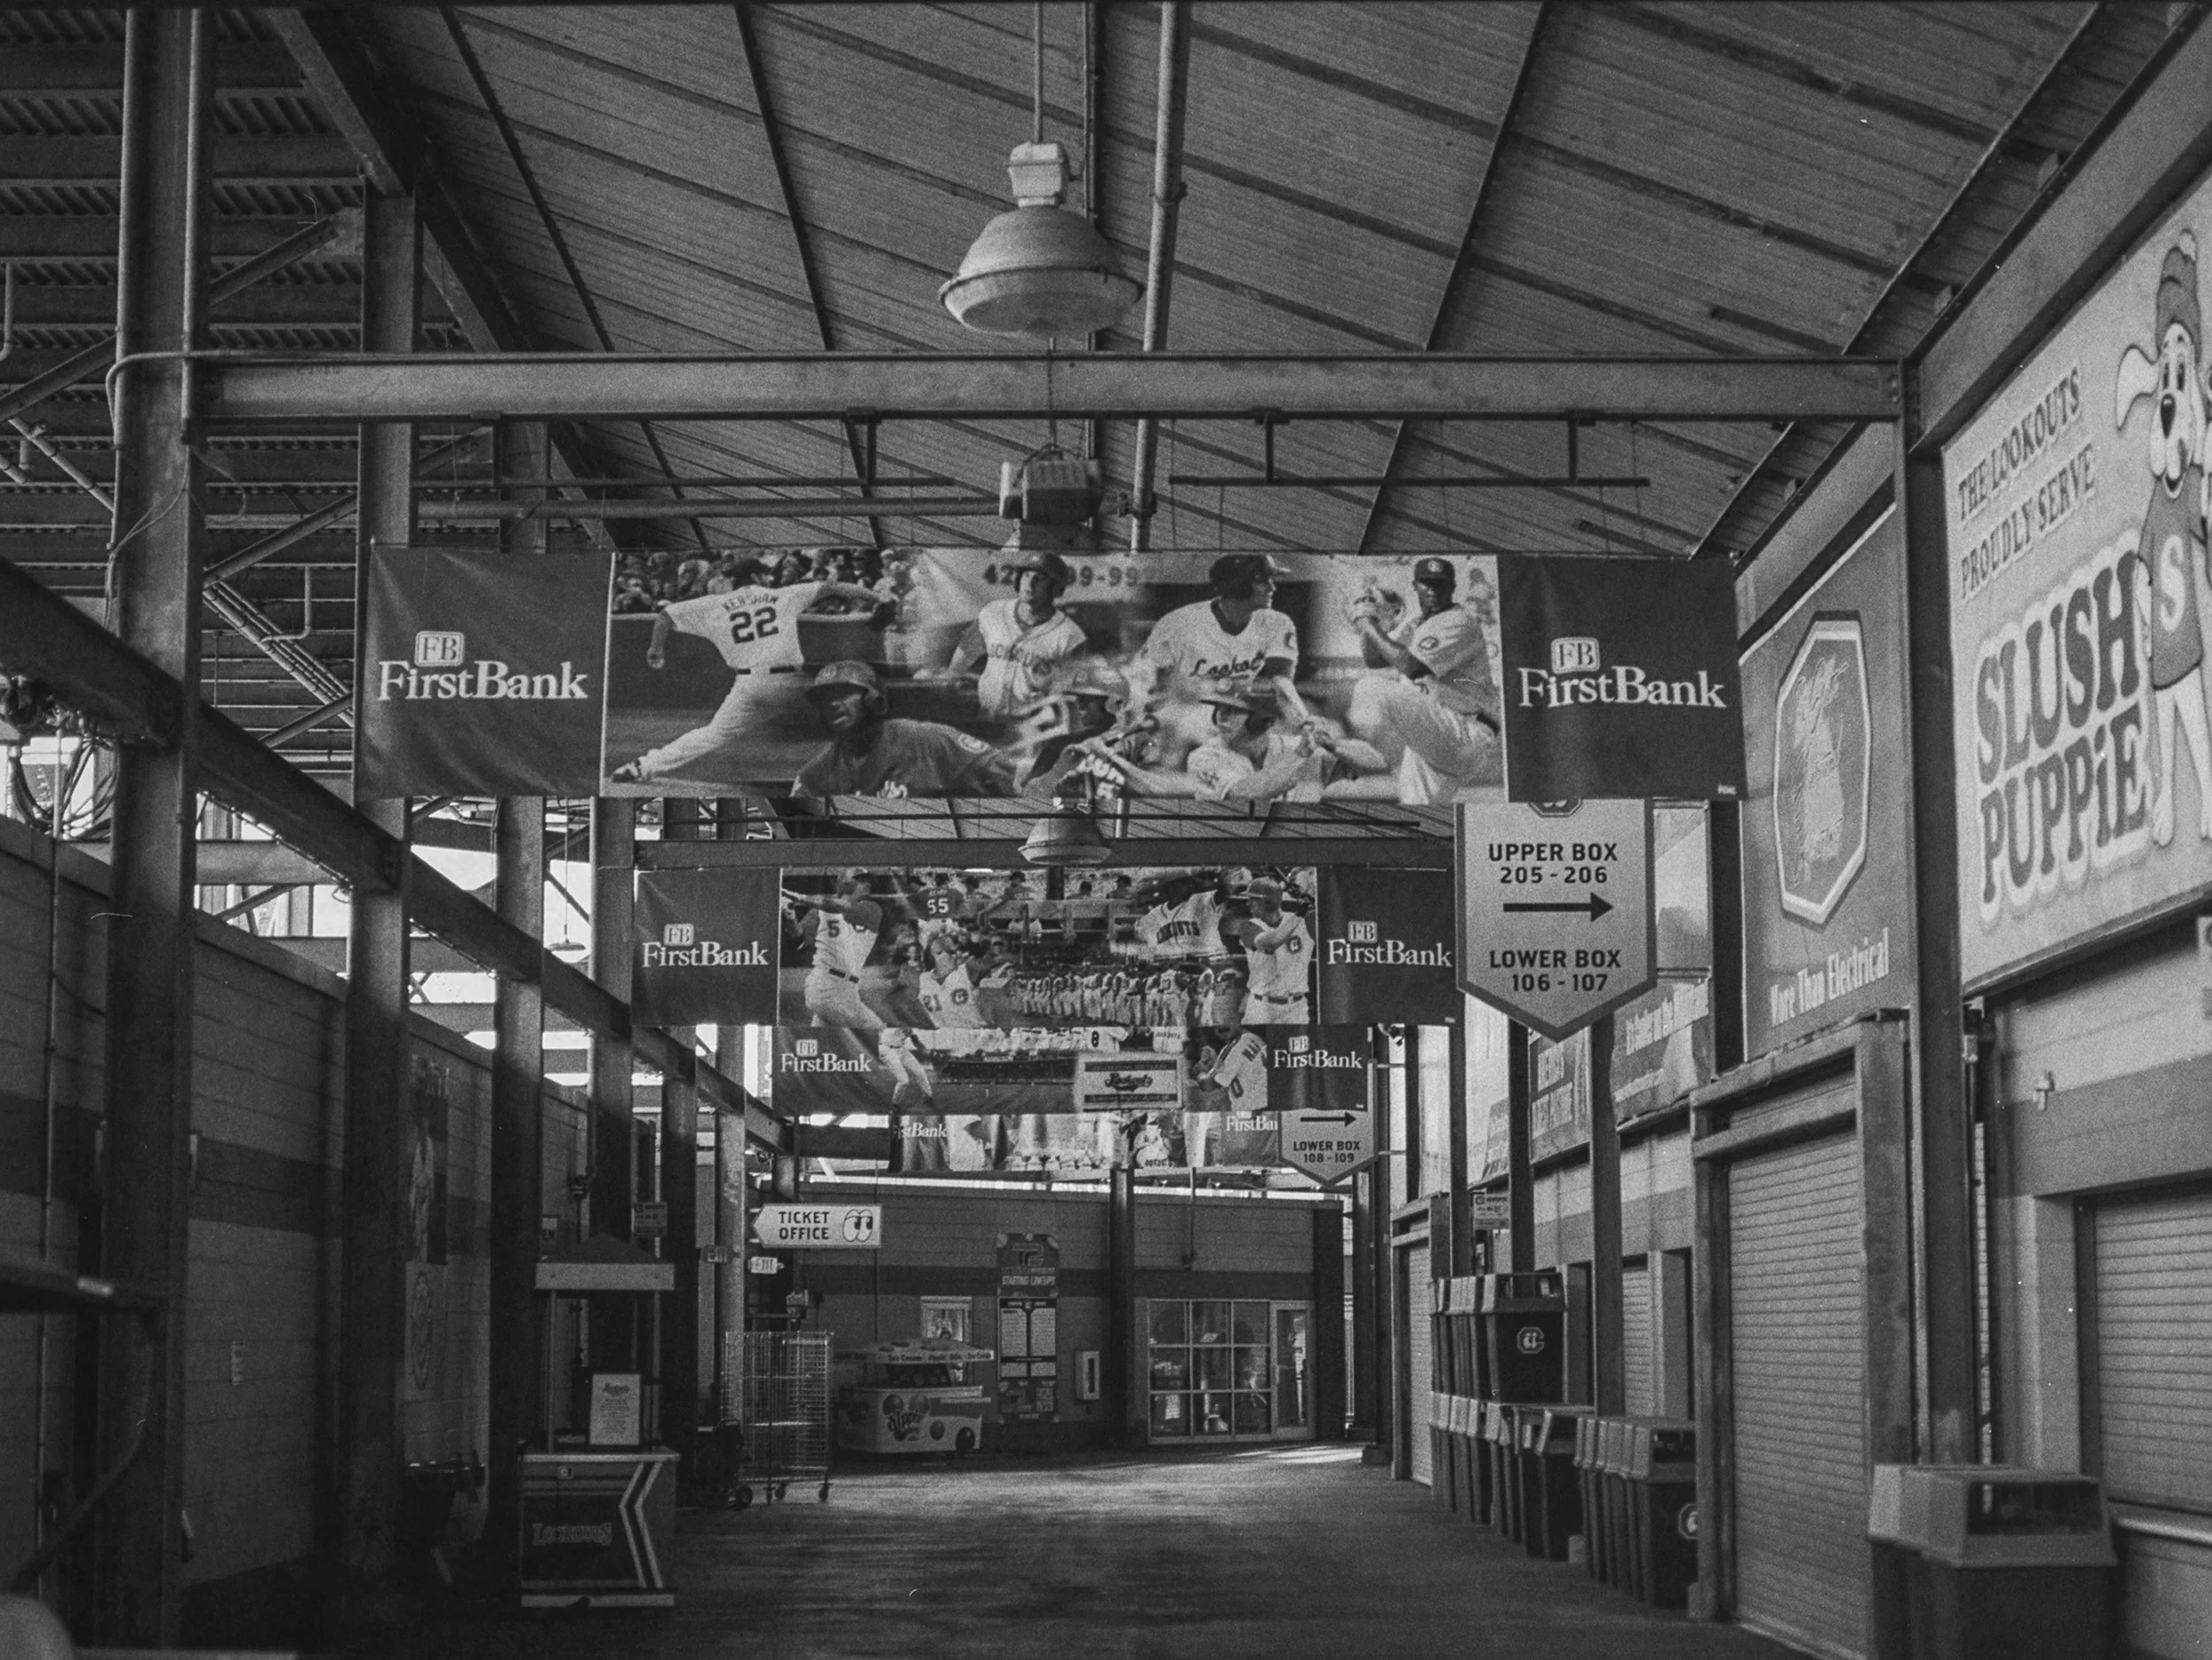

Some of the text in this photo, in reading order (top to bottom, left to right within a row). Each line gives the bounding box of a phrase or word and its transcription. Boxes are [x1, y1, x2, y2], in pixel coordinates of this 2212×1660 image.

[1959, 365, 2079, 521] THE LOOKOUTS
[1962, 442, 2095, 599] PROUDLY SERVE
[729, 605, 780, 644] 22
[421, 634, 459, 662] FB
[1557, 642, 1595, 669] FB
[1977, 549, 2139, 785] SLUSH
[377, 660, 588, 701] FirstBank
[1517, 665, 1728, 708] FirstBank
[1488, 842, 1618, 862] UPPER BOX
[1500, 865, 1543, 884] 205
[1563, 865, 1609, 884] 206
[926, 897, 949, 914] 55
[667, 926, 691, 943] FB
[641, 941, 770, 968] FirstBank
[1327, 938, 1453, 967] FirstBank
[1489, 949, 1622, 969] LOWER BOX
[1827, 926, 1890, 1001] Electrical
[1512, 973, 1551, 992] 106
[1572, 973, 1609, 992] 107
[781, 1053, 872, 1072] FirstBank
[1274, 1049, 1363, 1069] FirstBank
[898, 1122, 948, 1138] stBank
[1226, 1116, 1278, 1132] FirstBa
[1293, 1141, 1361, 1151] LOWER BOX
[1303, 1153, 1325, 1163] 108
[1334, 1153, 1355, 1163] 109
[779, 1211, 830, 1225] TICKET
[778, 1226, 830, 1240] OFFICE
